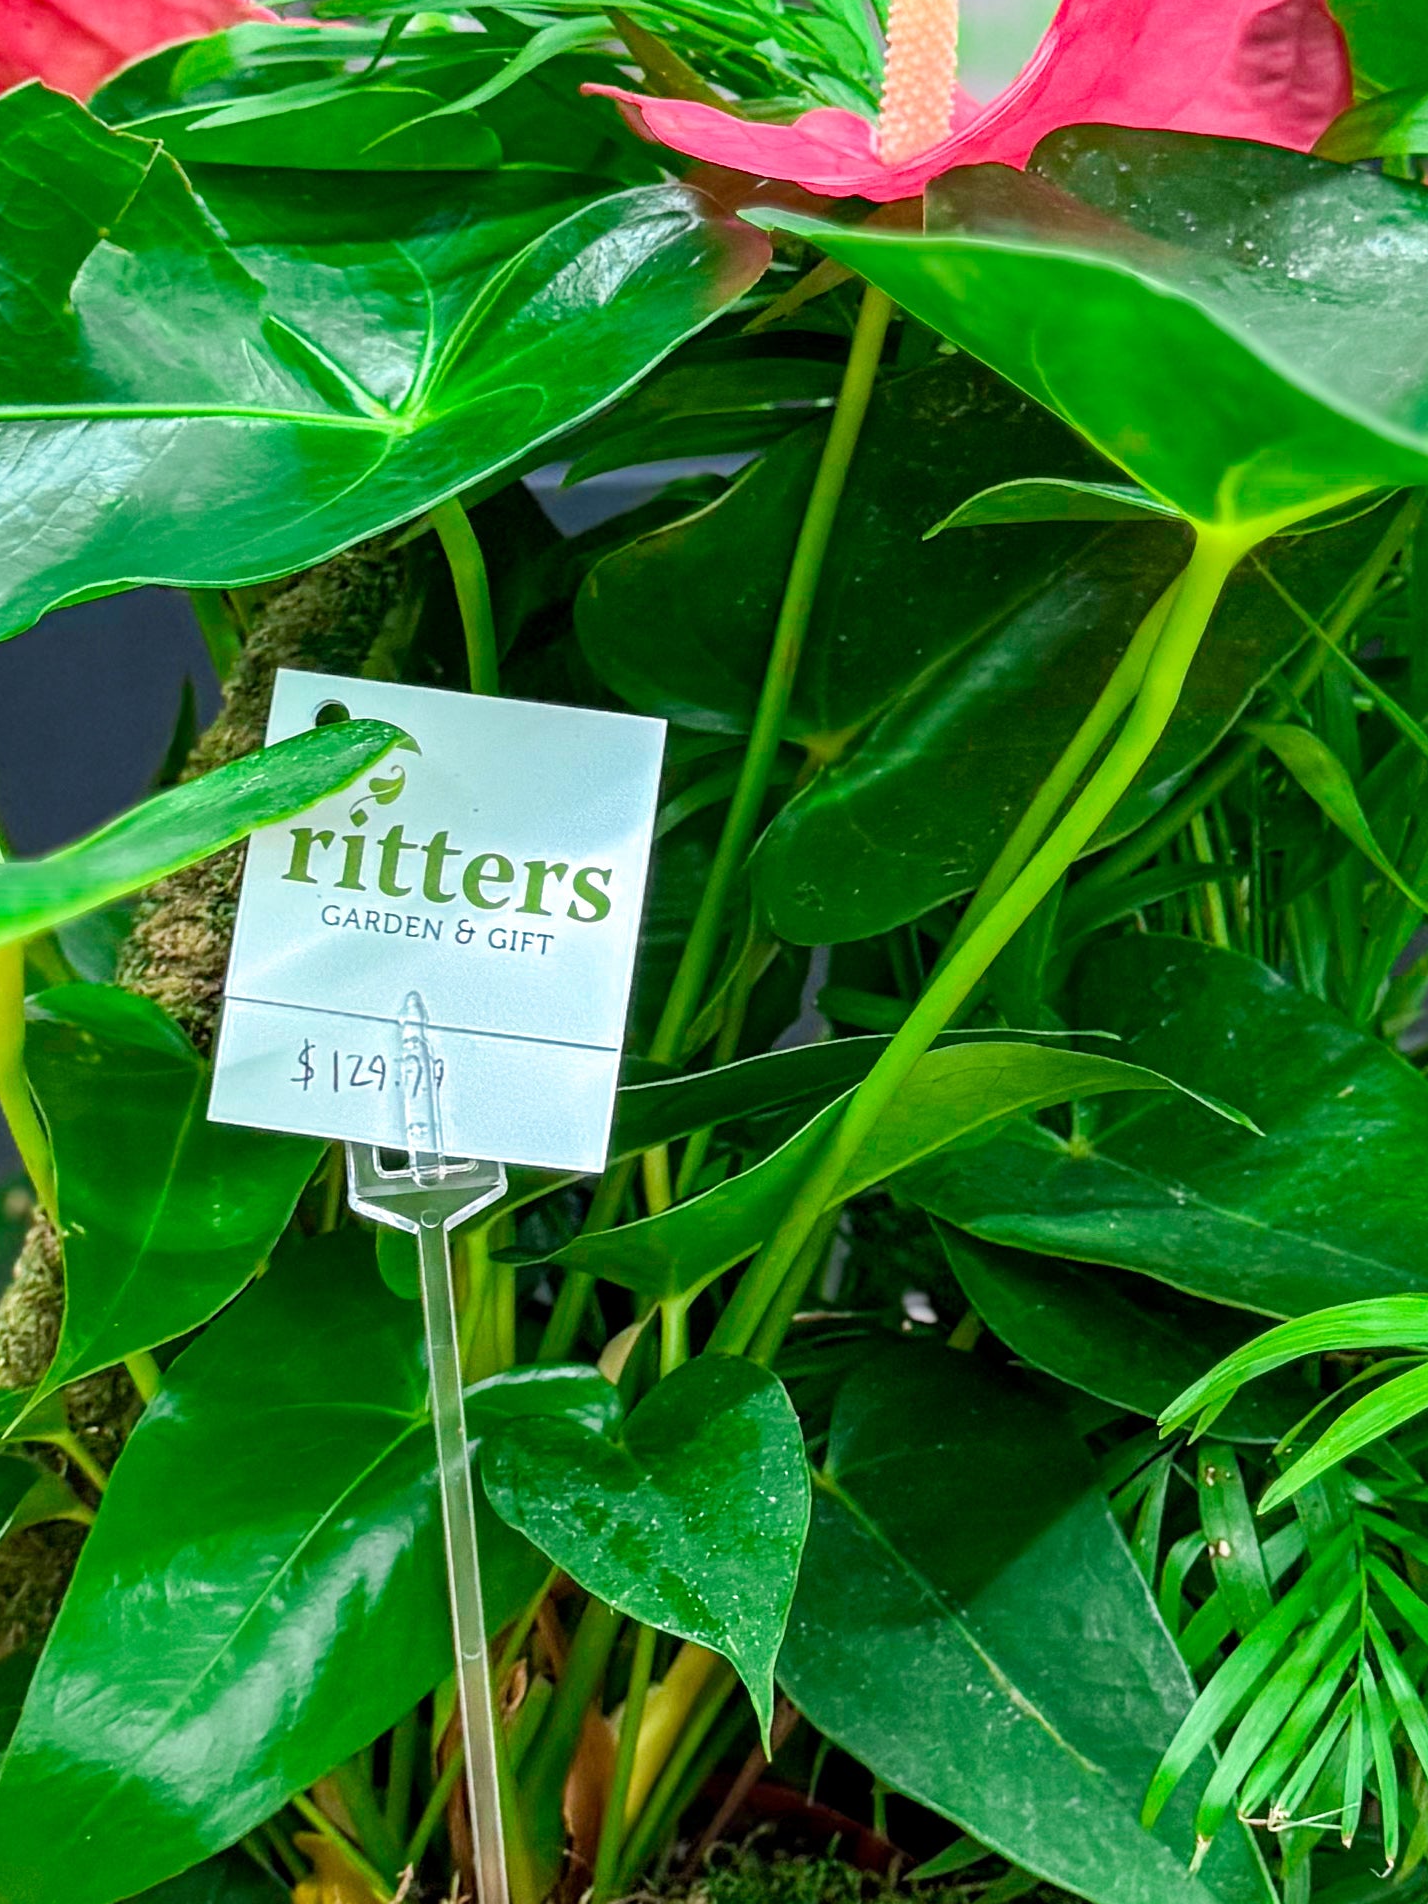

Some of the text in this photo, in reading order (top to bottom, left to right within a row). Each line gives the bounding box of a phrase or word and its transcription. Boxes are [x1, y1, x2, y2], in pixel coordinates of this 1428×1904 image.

[281, 808, 613, 923] ritters
[321, 904, 555, 956] GARDEN & GIFT
